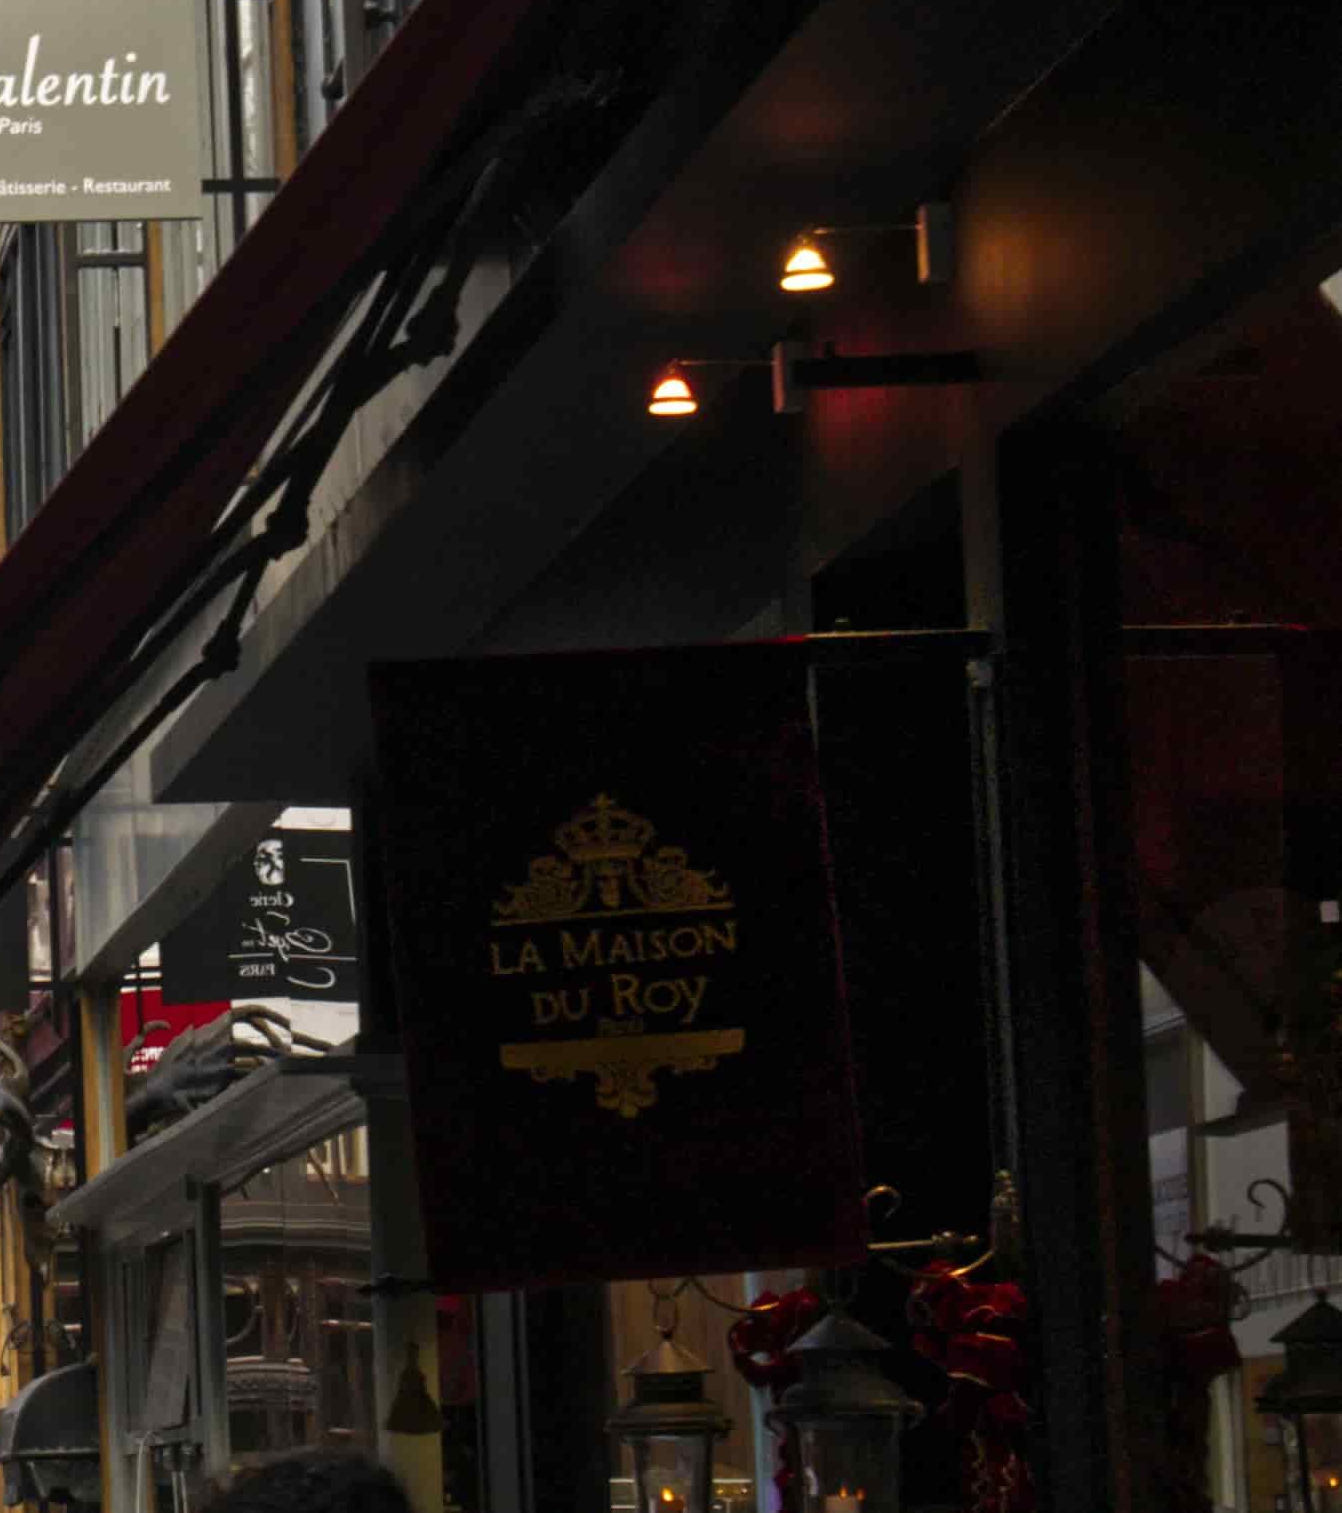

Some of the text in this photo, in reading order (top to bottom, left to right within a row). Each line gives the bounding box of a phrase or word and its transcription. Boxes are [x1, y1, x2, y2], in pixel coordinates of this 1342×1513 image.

[82, 177, 172, 194] Restaurant
[489, 939, 548, 976] LA
[530, 989, 594, 1026] DU
